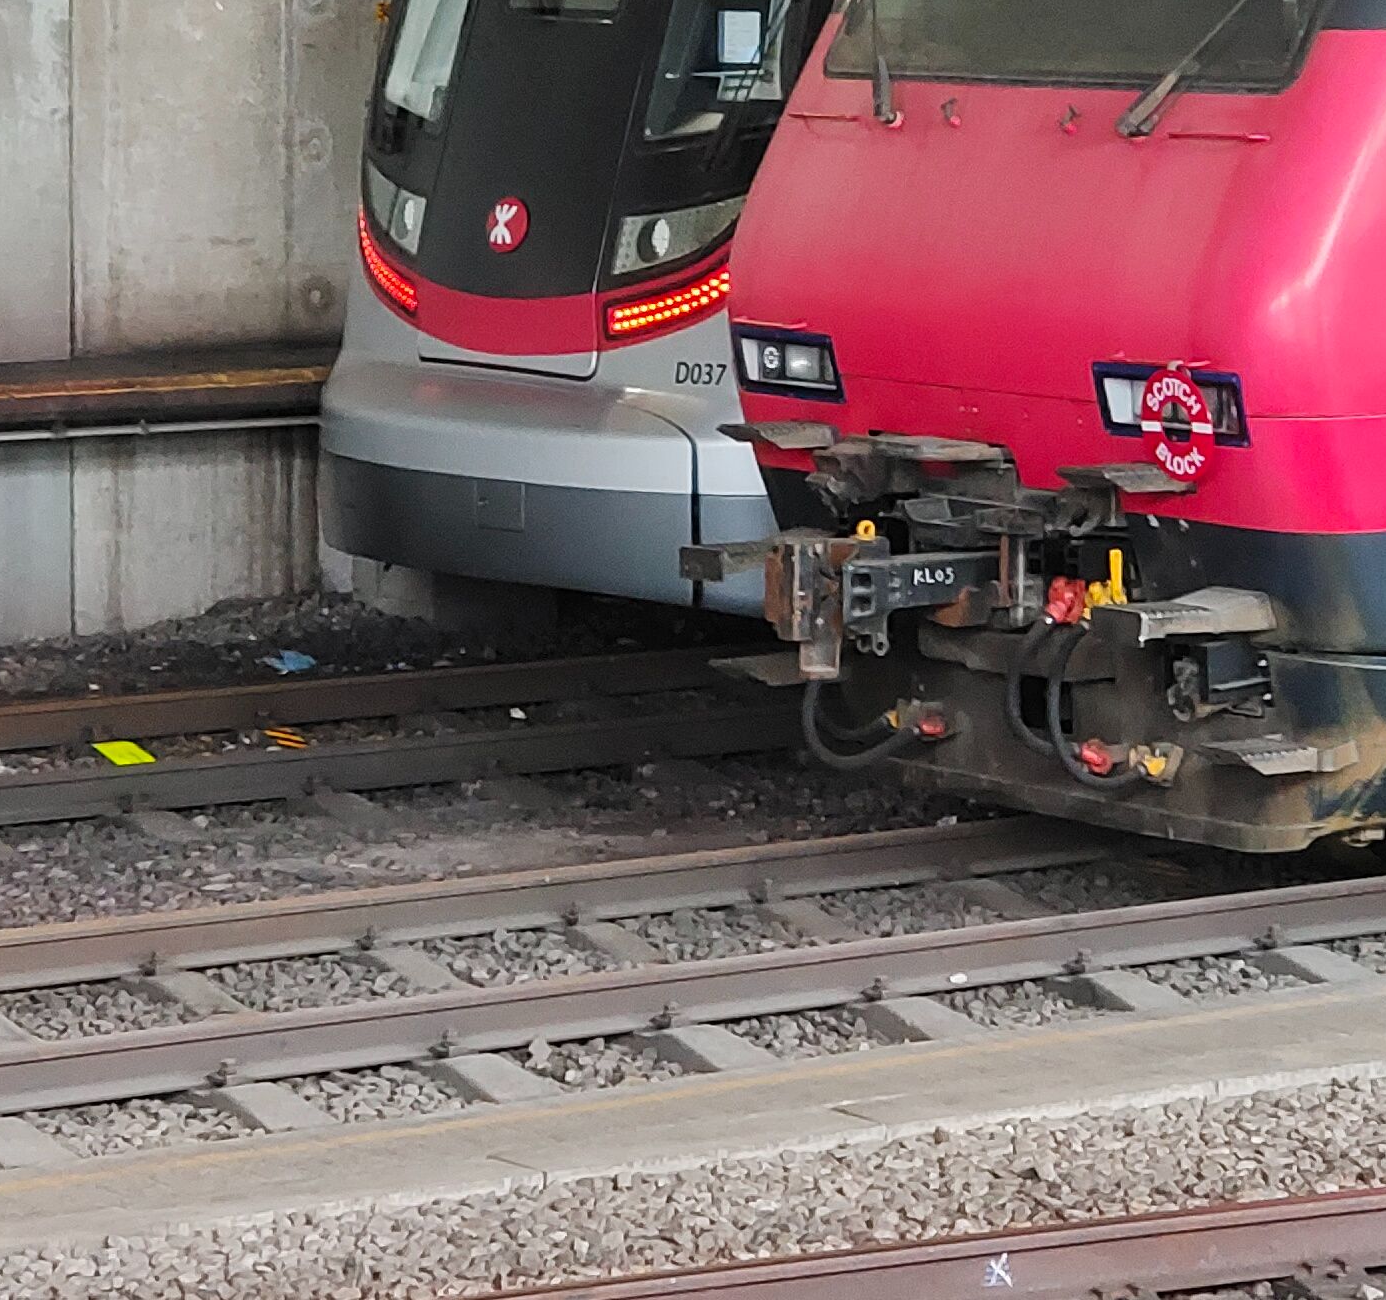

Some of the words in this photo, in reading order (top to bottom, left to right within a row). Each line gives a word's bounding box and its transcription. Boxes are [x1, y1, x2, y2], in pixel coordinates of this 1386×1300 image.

[675, 361, 727, 386] D037
[1146, 377, 1202, 416] SCOTCH
[1155, 441, 1206, 475] BLOCK
